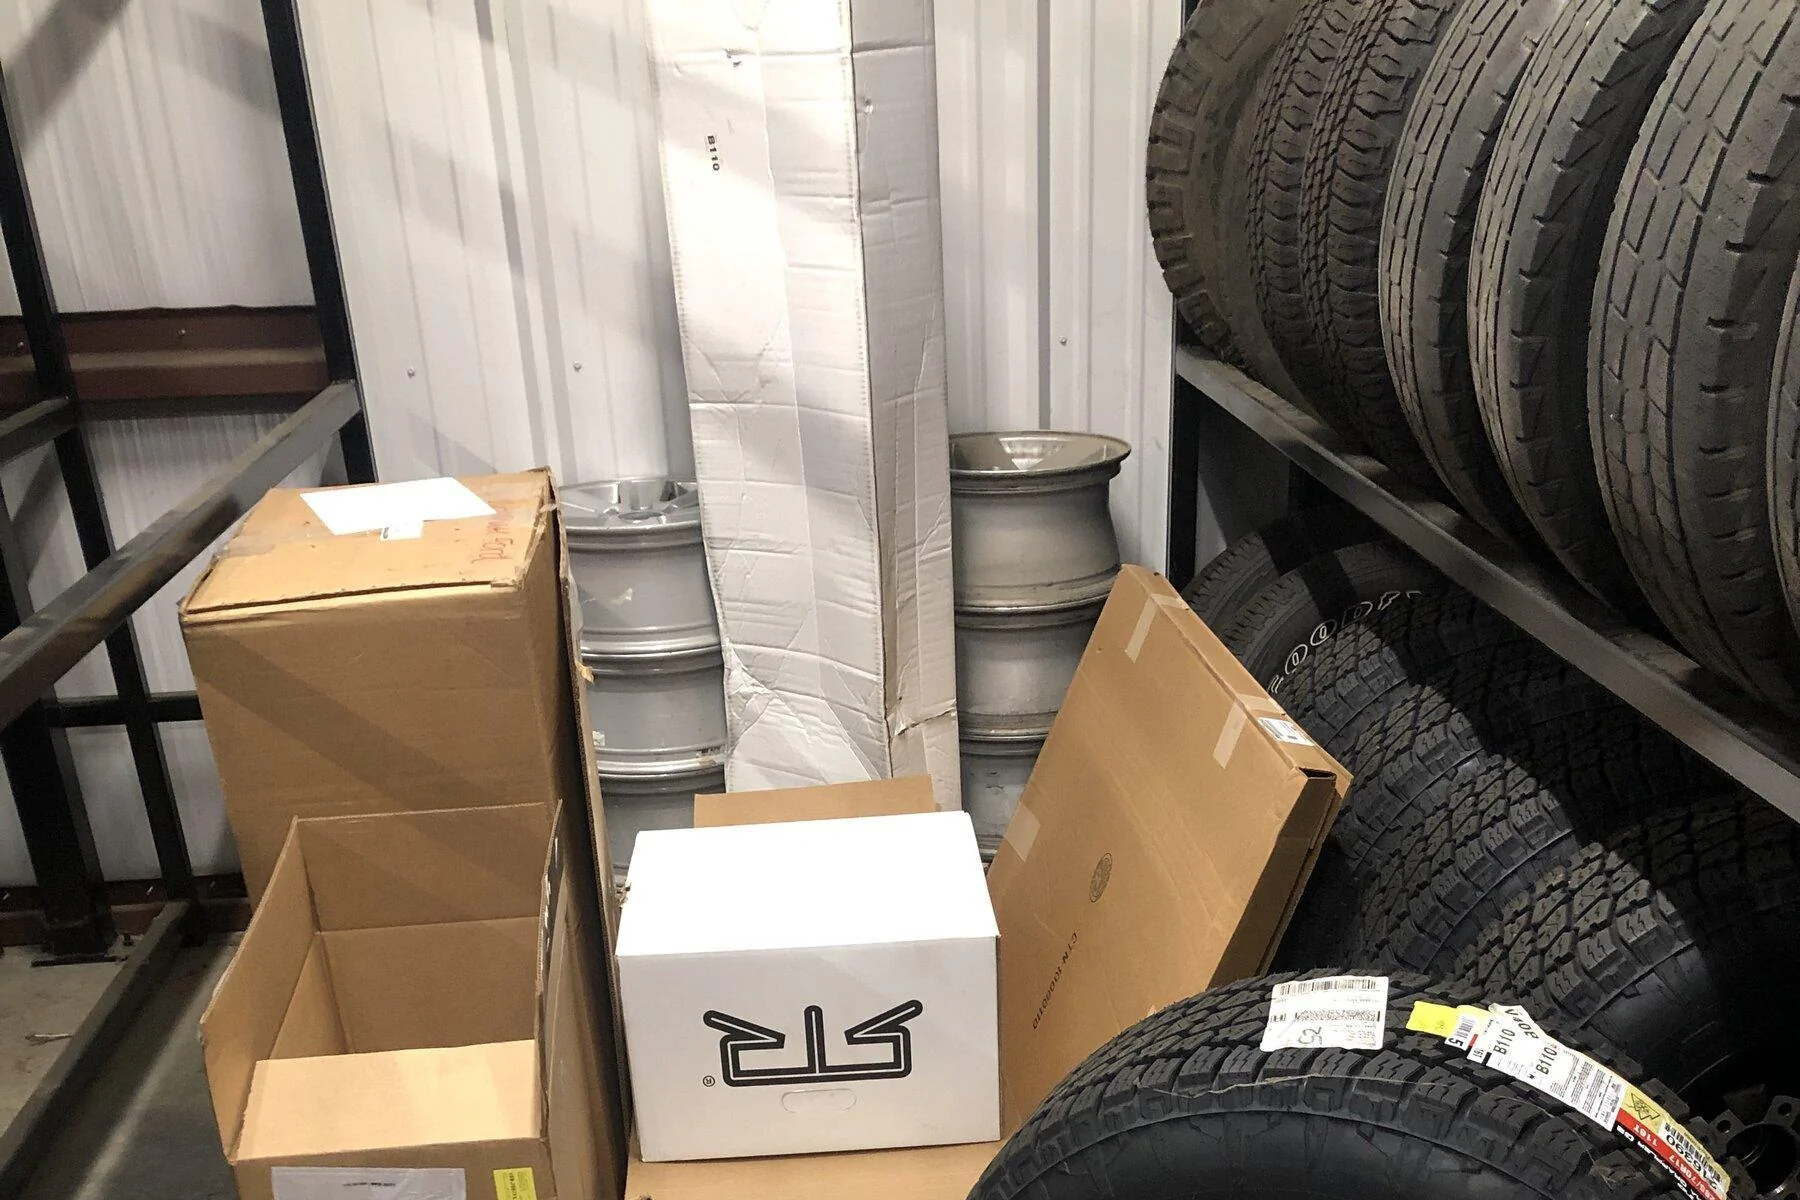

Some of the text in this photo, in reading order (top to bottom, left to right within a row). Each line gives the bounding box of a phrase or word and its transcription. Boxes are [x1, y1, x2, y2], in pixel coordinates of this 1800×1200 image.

[707, 135, 720, 171] B110
[1493, 1028, 1516, 1055] B110
[1536, 1046, 1558, 1075] B110
[1666, 1134, 1718, 1190] 216390
